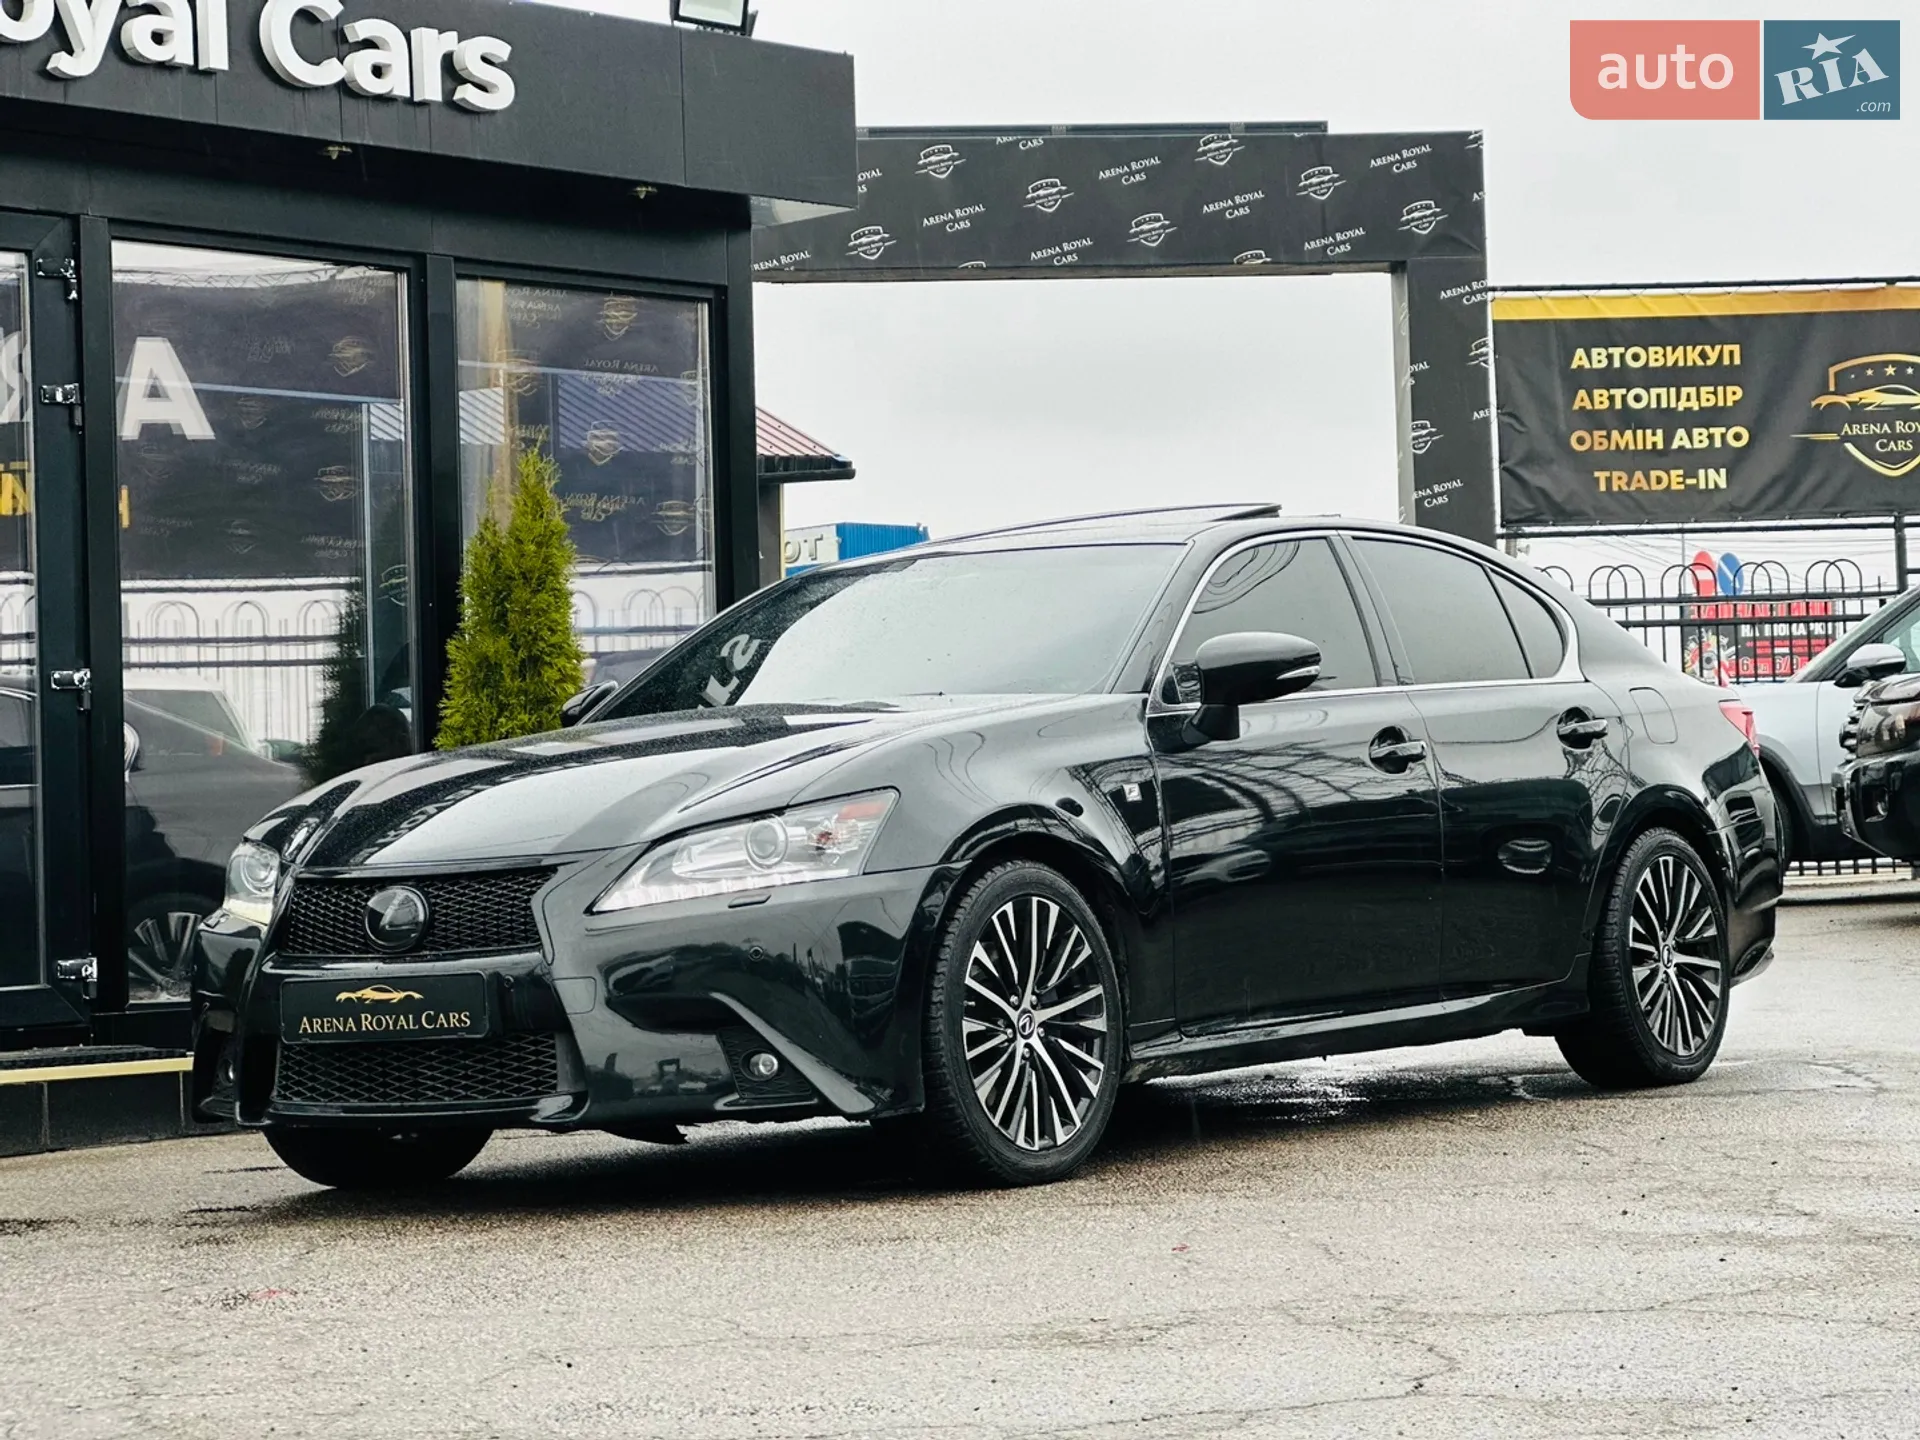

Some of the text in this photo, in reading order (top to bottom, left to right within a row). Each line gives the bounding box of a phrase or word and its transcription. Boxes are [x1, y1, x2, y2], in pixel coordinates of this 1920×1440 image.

[259, 0, 515, 112] Cars
[1018, 137, 1045, 151] CARS
[1369, 143, 1433, 169] ARENA ROYAL
[1099, 155, 1162, 180] ARENA ROYAL
[1391, 158, 1418, 174] CARS
[857, 168, 883, 183] OYAL
[1121, 171, 1147, 186] CARS
[1202, 189, 1265, 214] ARENA ROYAL
[922, 203, 987, 228] ARENA ROYAL
[1225, 205, 1251, 219] CARS
[945, 219, 972, 233] CARS
[1303, 226, 1366, 251] ARENA ROYAL
[1030, 237, 1094, 261] ARENA ROYAL
[1326, 242, 1352, 257] CARS
[752, 258, 779, 271] RENA
[780, 250, 811, 265] ROYAL
[1052, 252, 1079, 267] CARS
[1440, 285, 1472, 300] ARENA
[1462, 292, 1488, 306] CARS
[1570, 344, 1742, 370] АВТОВИКУП
[1572, 386, 1744, 411] АВТОПІДБІР
[1840, 422, 1892, 436] ARENA
[1569, 425, 1750, 452] ОБМІН АВТО
[1875, 438, 1914, 453] CARS
[1433, 478, 1464, 494] ROYAL
[1593, 467, 1728, 492] TRADE-IN
[1423, 494, 1449, 508] CARS
[299, 1010, 471, 1034] ARENA ROYAL CARS
